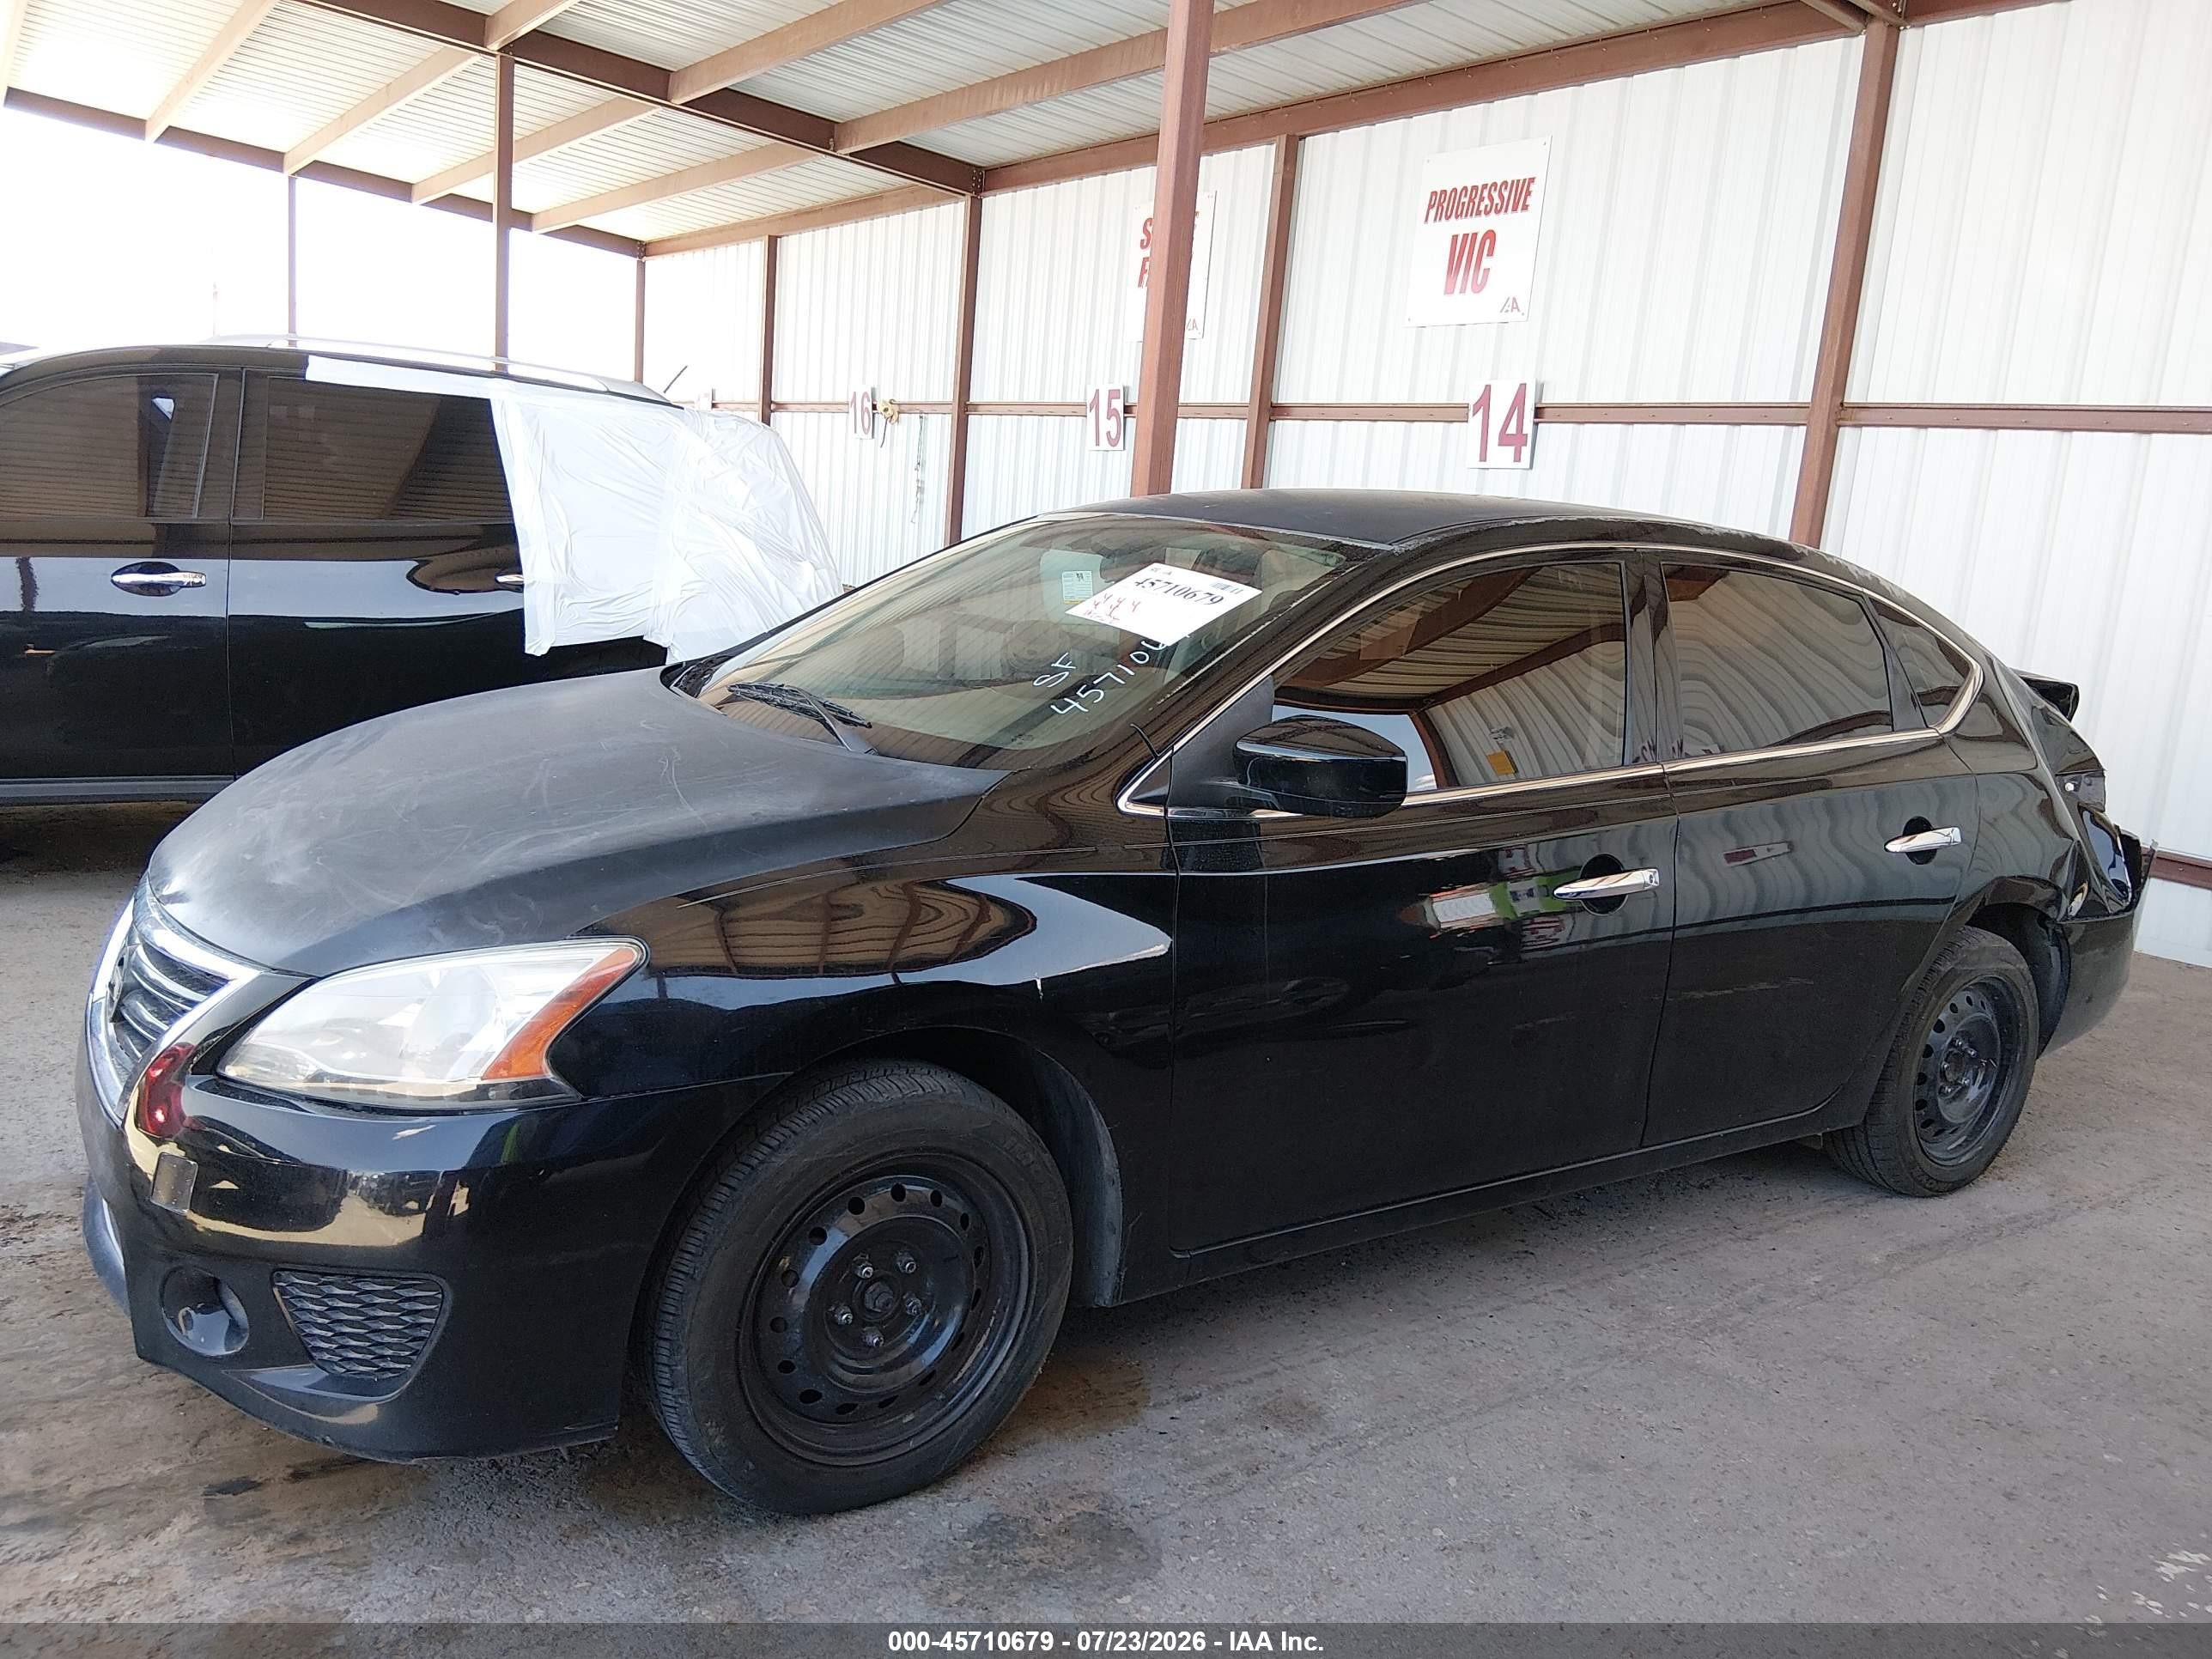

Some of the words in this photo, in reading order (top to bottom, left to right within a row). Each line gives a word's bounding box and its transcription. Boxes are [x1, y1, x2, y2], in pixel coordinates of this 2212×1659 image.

[1424, 176, 1536, 225] PROGRESSIVE
[1443, 228, 1497, 295] VIC
[849, 390, 872, 435] 16
[1088, 388, 1121, 447] 15
[1471, 382, 1528, 463] 14
[1133, 576, 1224, 606] 45710679
[1032, 652, 1077, 688] SF
